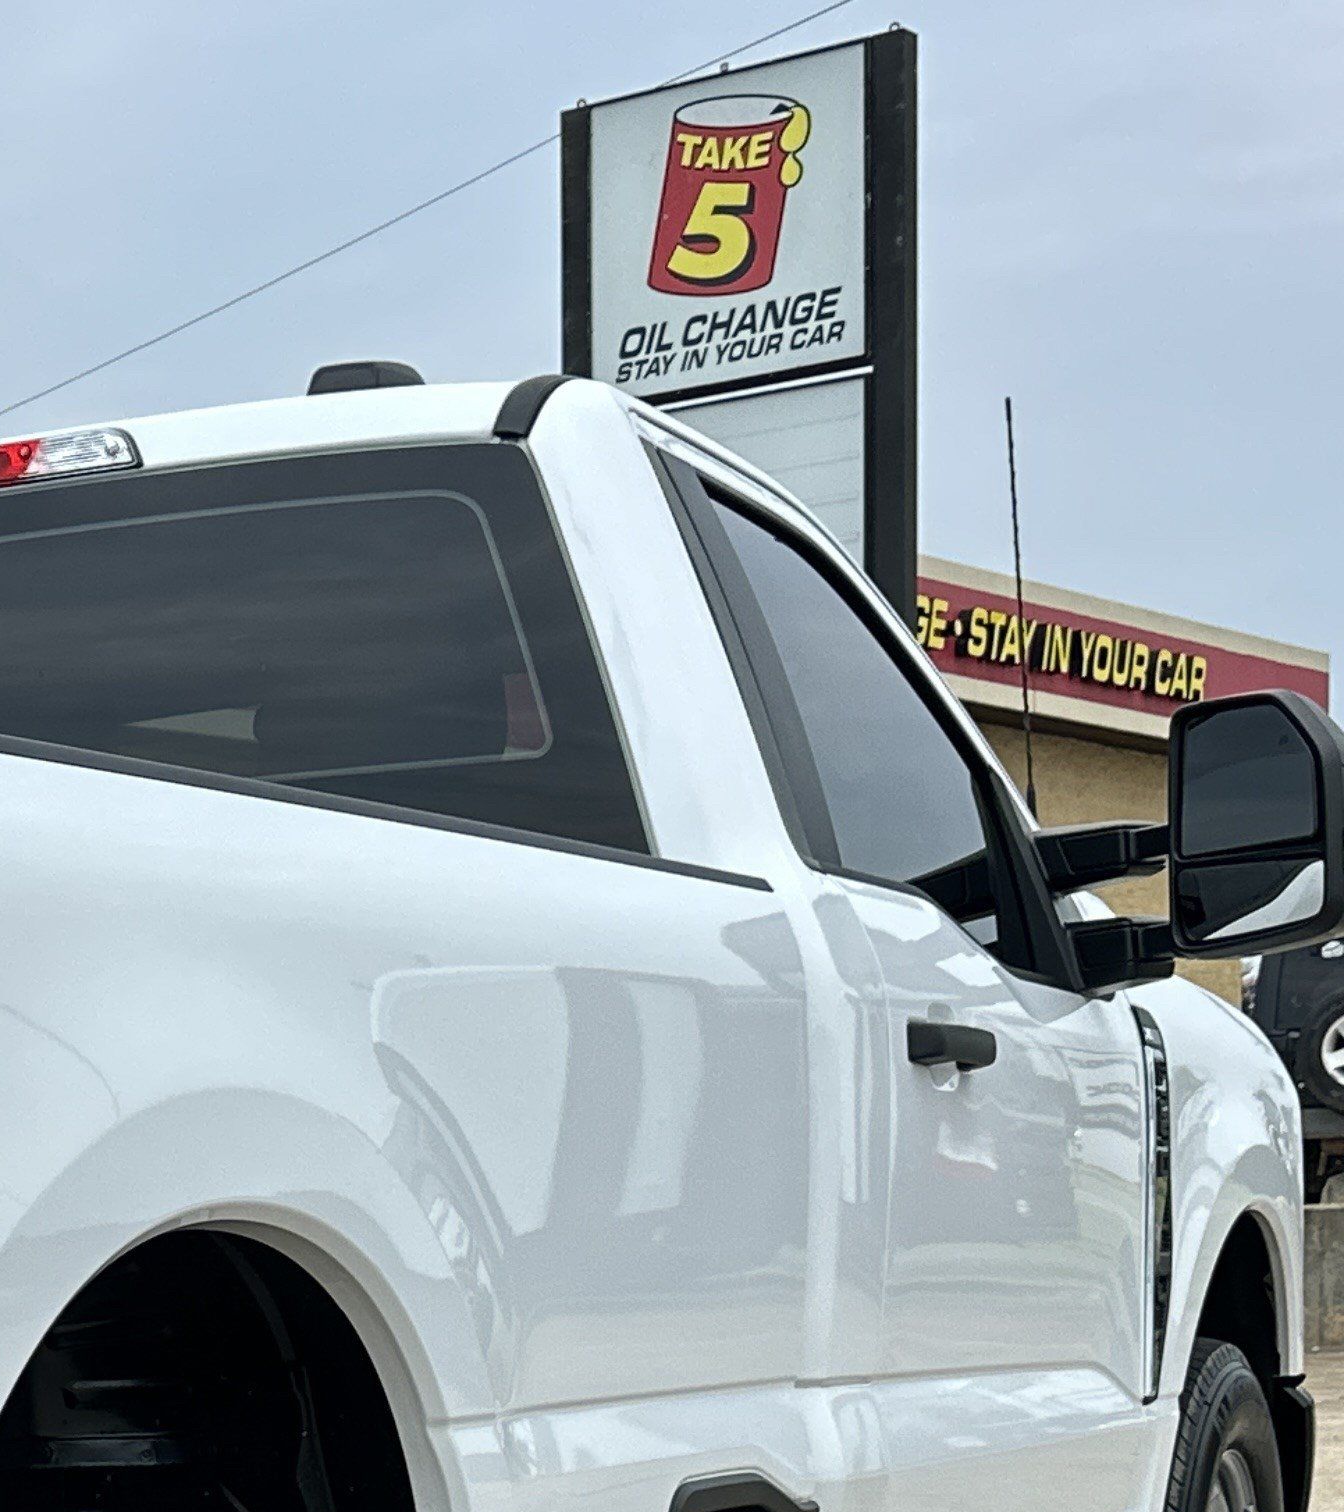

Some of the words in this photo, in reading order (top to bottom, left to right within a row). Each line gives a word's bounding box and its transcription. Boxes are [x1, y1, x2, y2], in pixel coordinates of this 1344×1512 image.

[676, 131, 775, 171] TAKE
[666, 181, 755, 286] 5
[615, 351, 677, 384] STAY
[680, 346, 707, 372] IN
[716, 333, 783, 366] YOUR
[790, 320, 845, 351] CAR
[619, 321, 673, 359] OIL
[682, 286, 842, 345] CHANGE
[967, 607, 1037, 665] STAY
[1041, 623, 1072, 674] IN
[1080, 630, 1150, 691] YOUR
[1154, 648, 1207, 702] CAR
